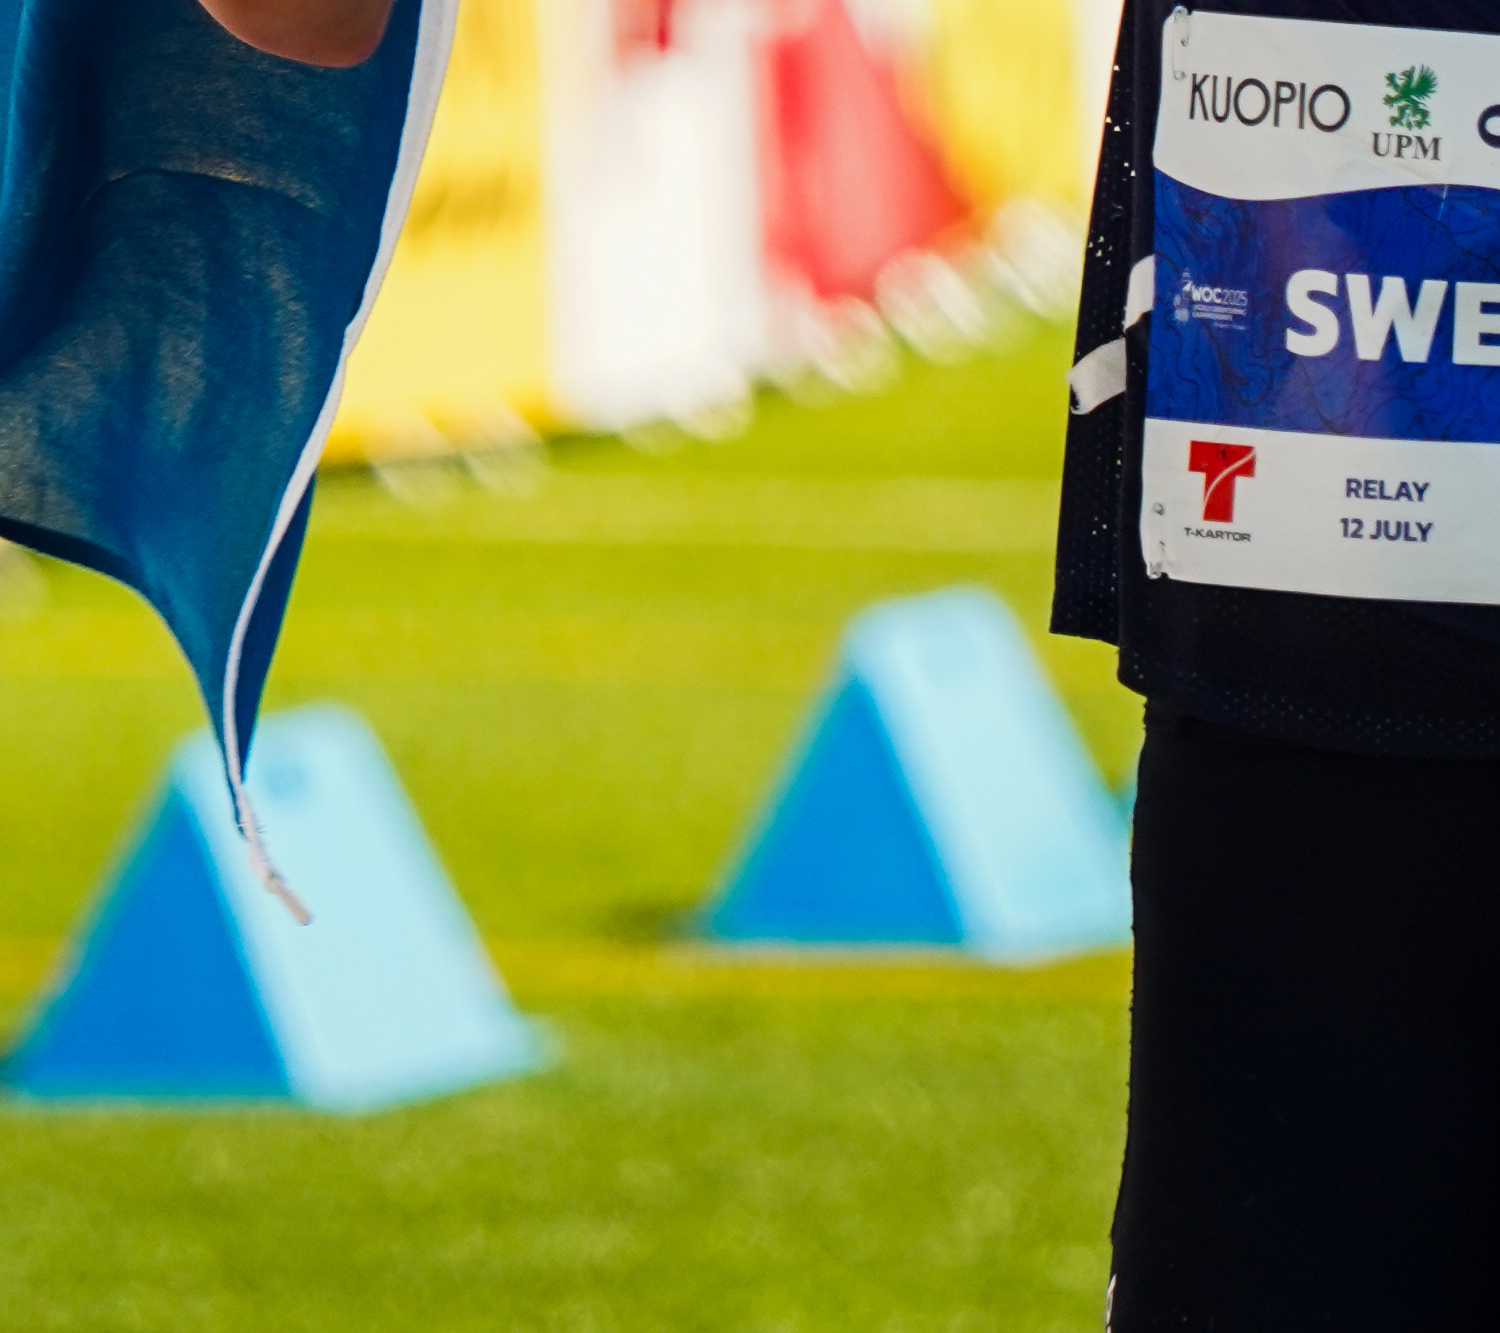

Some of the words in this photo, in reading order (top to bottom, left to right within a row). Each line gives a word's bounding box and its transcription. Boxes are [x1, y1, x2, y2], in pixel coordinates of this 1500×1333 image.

[1188, 71, 1352, 134] KUOPIO
[1371, 132, 1442, 162] UPM
[1345, 477, 1431, 503] RELAY
[1184, 526, 1252, 543] T-KARTOR
[1340, 517, 1364, 541] 12
[1368, 519, 1434, 543] JULY
